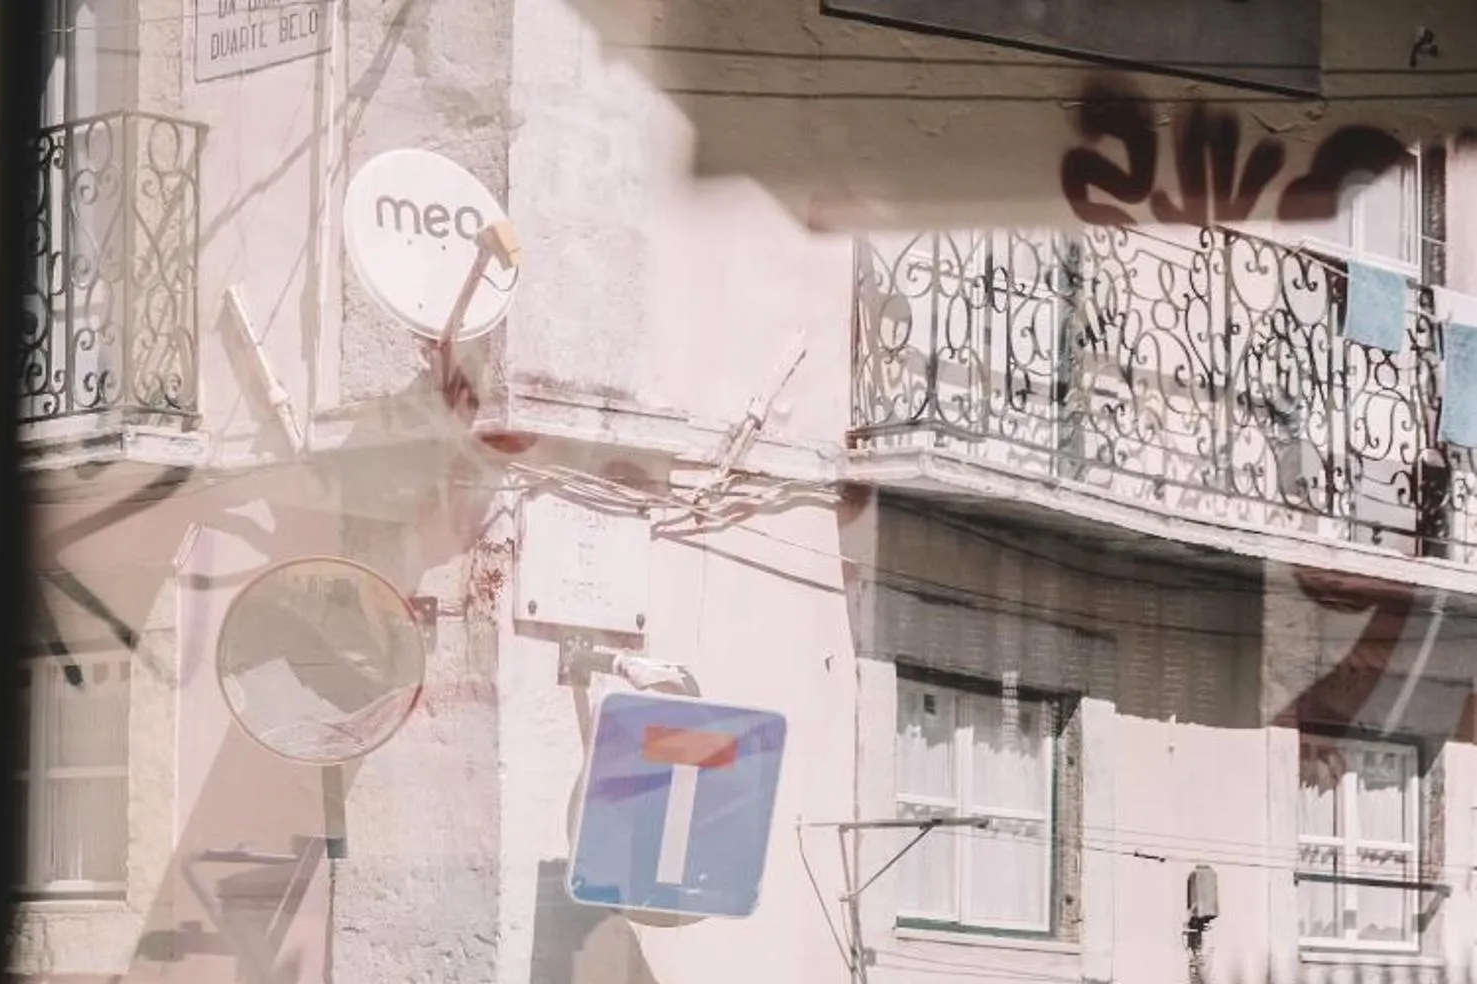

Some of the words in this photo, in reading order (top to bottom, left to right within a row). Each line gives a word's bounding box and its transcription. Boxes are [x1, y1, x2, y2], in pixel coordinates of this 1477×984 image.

[210, 23, 267, 60] DUARTE
[279, 9, 318, 43] BELO
[376, 195, 484, 240] meo
